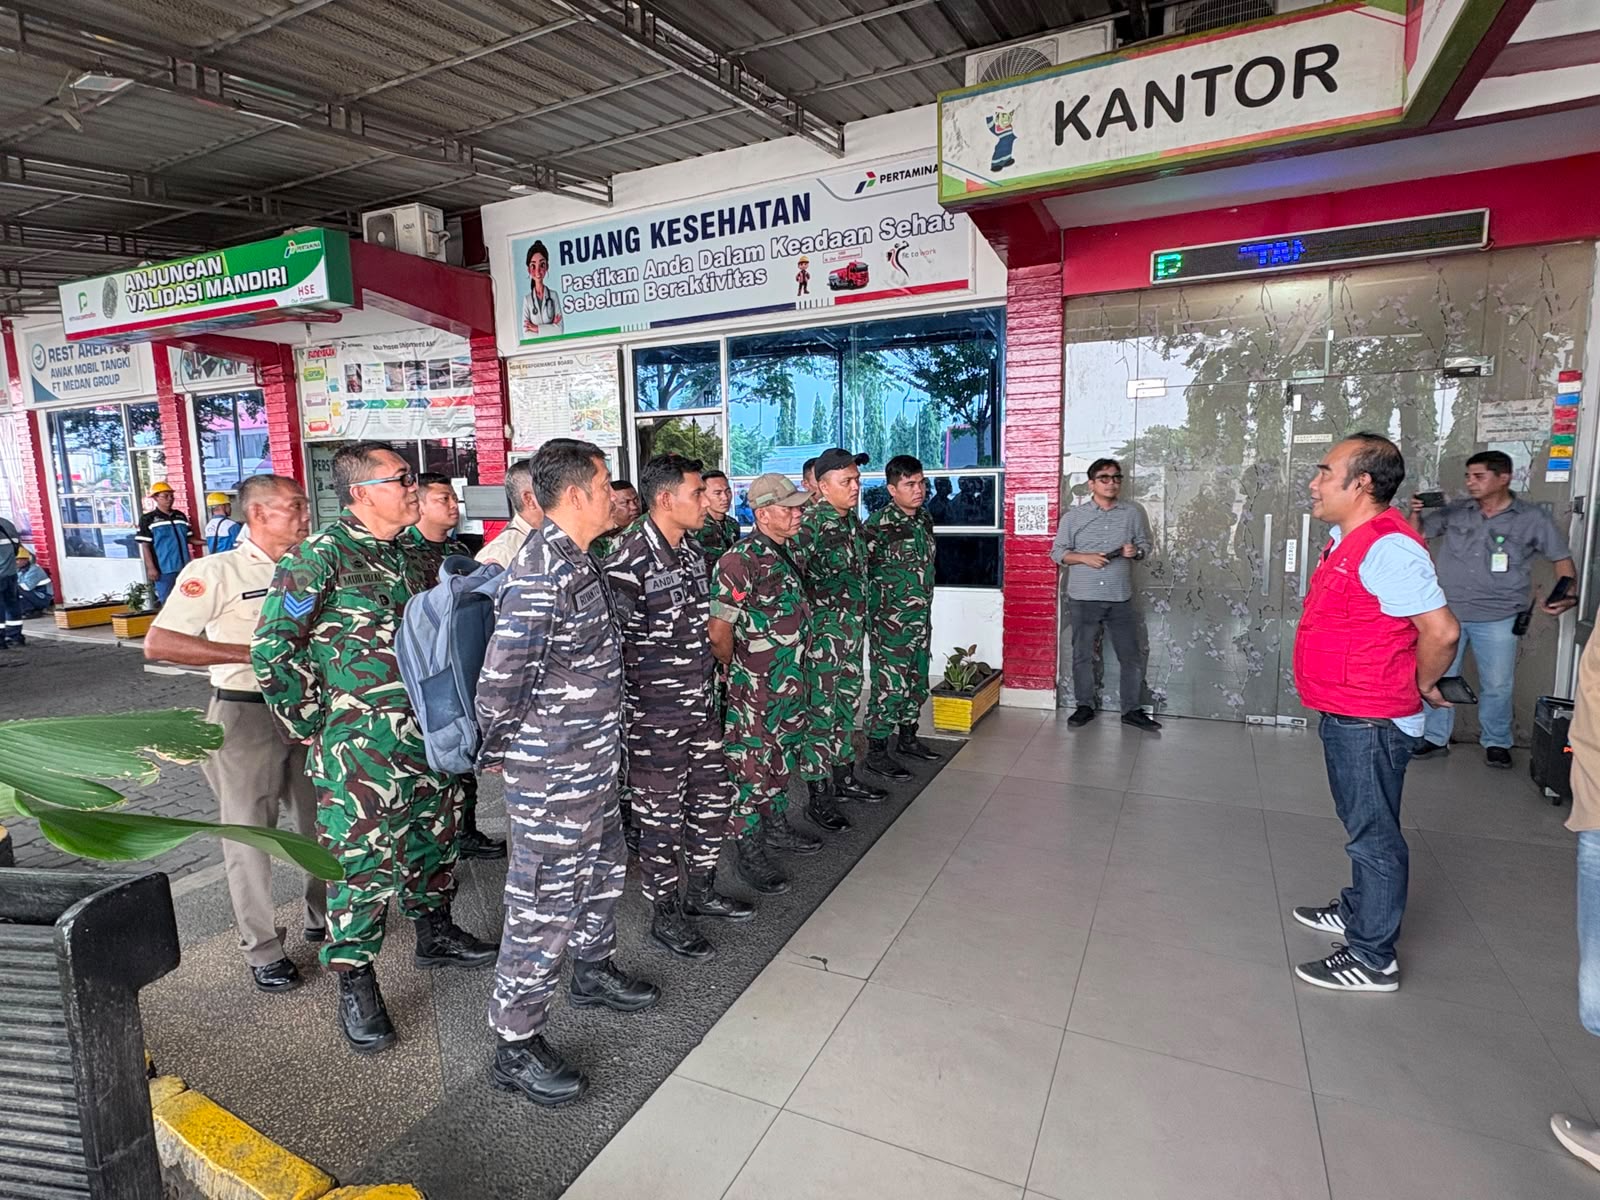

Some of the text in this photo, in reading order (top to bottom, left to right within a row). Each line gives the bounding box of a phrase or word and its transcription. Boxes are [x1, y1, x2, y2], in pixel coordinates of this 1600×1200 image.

[1054, 43, 1340, 146] KANTOR
[879, 163, 938, 184] PERTAMINA
[559, 192, 811, 266] RUANG KESEHATAN
[561, 265, 639, 293] Pastikan
[643, 255, 693, 280] Anda
[699, 246, 764, 271] Dalam
[771, 225, 873, 259] Keadaan
[879, 211, 955, 241] Sehat
[124, 255, 223, 293] ANJUNGAN
[126, 266, 288, 313] VALIDASI MANDIRI
[297, 284, 315, 295] HSE
[563, 267, 768, 314] Sebelum Beraktivitas
[48, 345, 74, 363] REST
[79, 343, 108, 358] AREA
[50, 357, 130, 379] AWAK MOBIL TANGKI
[522, 361, 557, 369] PERFORMANCE
[63, 378, 91, 390] MEDAN
[92, 373, 120, 386] GROUP
[653, 575, 675, 590] ANDI
